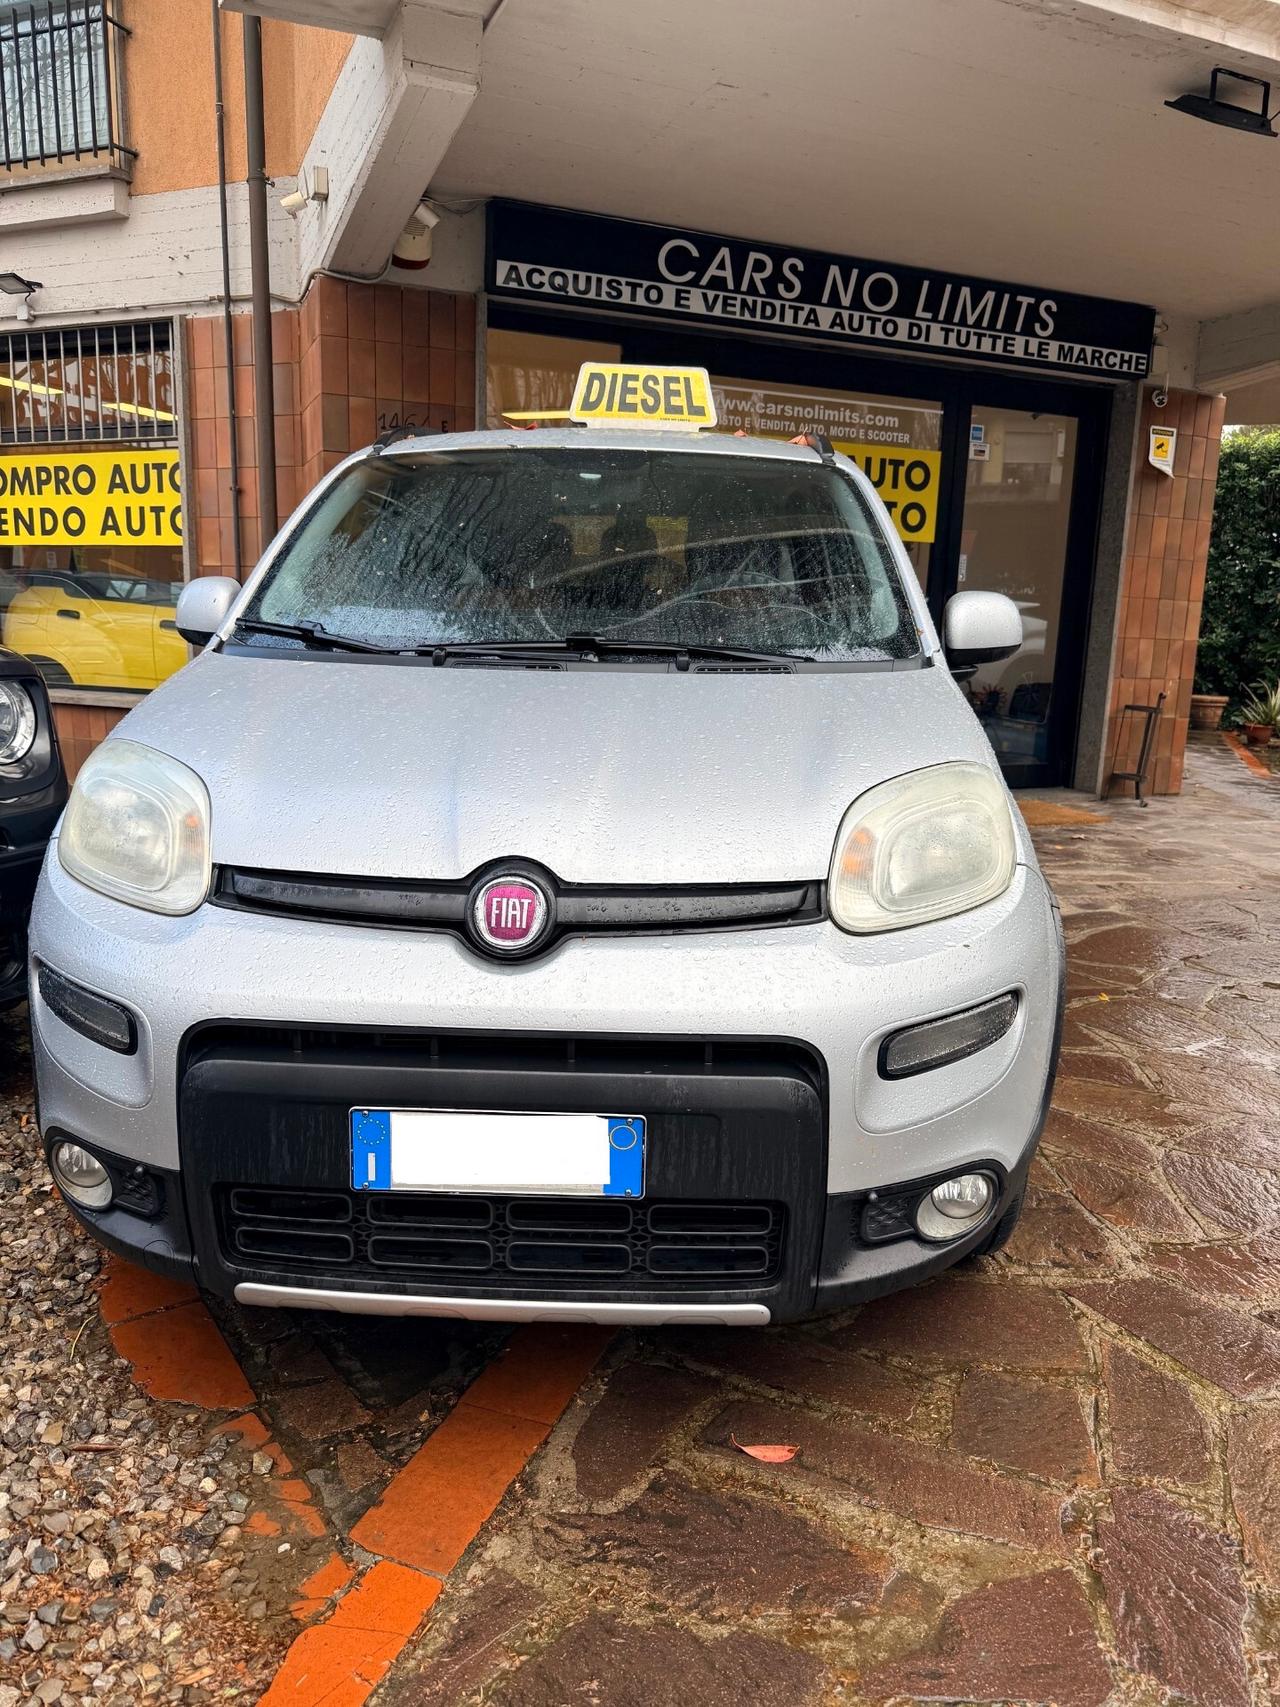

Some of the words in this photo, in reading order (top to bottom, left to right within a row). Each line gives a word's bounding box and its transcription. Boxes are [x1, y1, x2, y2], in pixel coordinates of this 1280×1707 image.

[658, 238, 805, 299] CARS
[821, 265, 898, 312] NO
[915, 280, 1057, 338] LIMITS
[502, 264, 664, 305] ACQUISTO
[674, 289, 691, 309] E
[701, 292, 820, 328] VENDITA
[829, 311, 899, 338] AUTO
[907, 322, 930, 343] DI
[940, 326, 1015, 355] TUTTE
[1023, 338, 1049, 359] LE
[1057, 344, 1147, 374] MARCHE
[580, 372, 706, 416] DIESEL
[745, 417, 751, 428] E
[754, 418, 796, 432] VENDITA
[829, 425, 857, 438] MOTO
[859, 429, 866, 438] E
[867, 430, 910, 444] SCOOTER
[847, 455, 931, 492] UTO
[490, 897, 532, 929] FIAT
